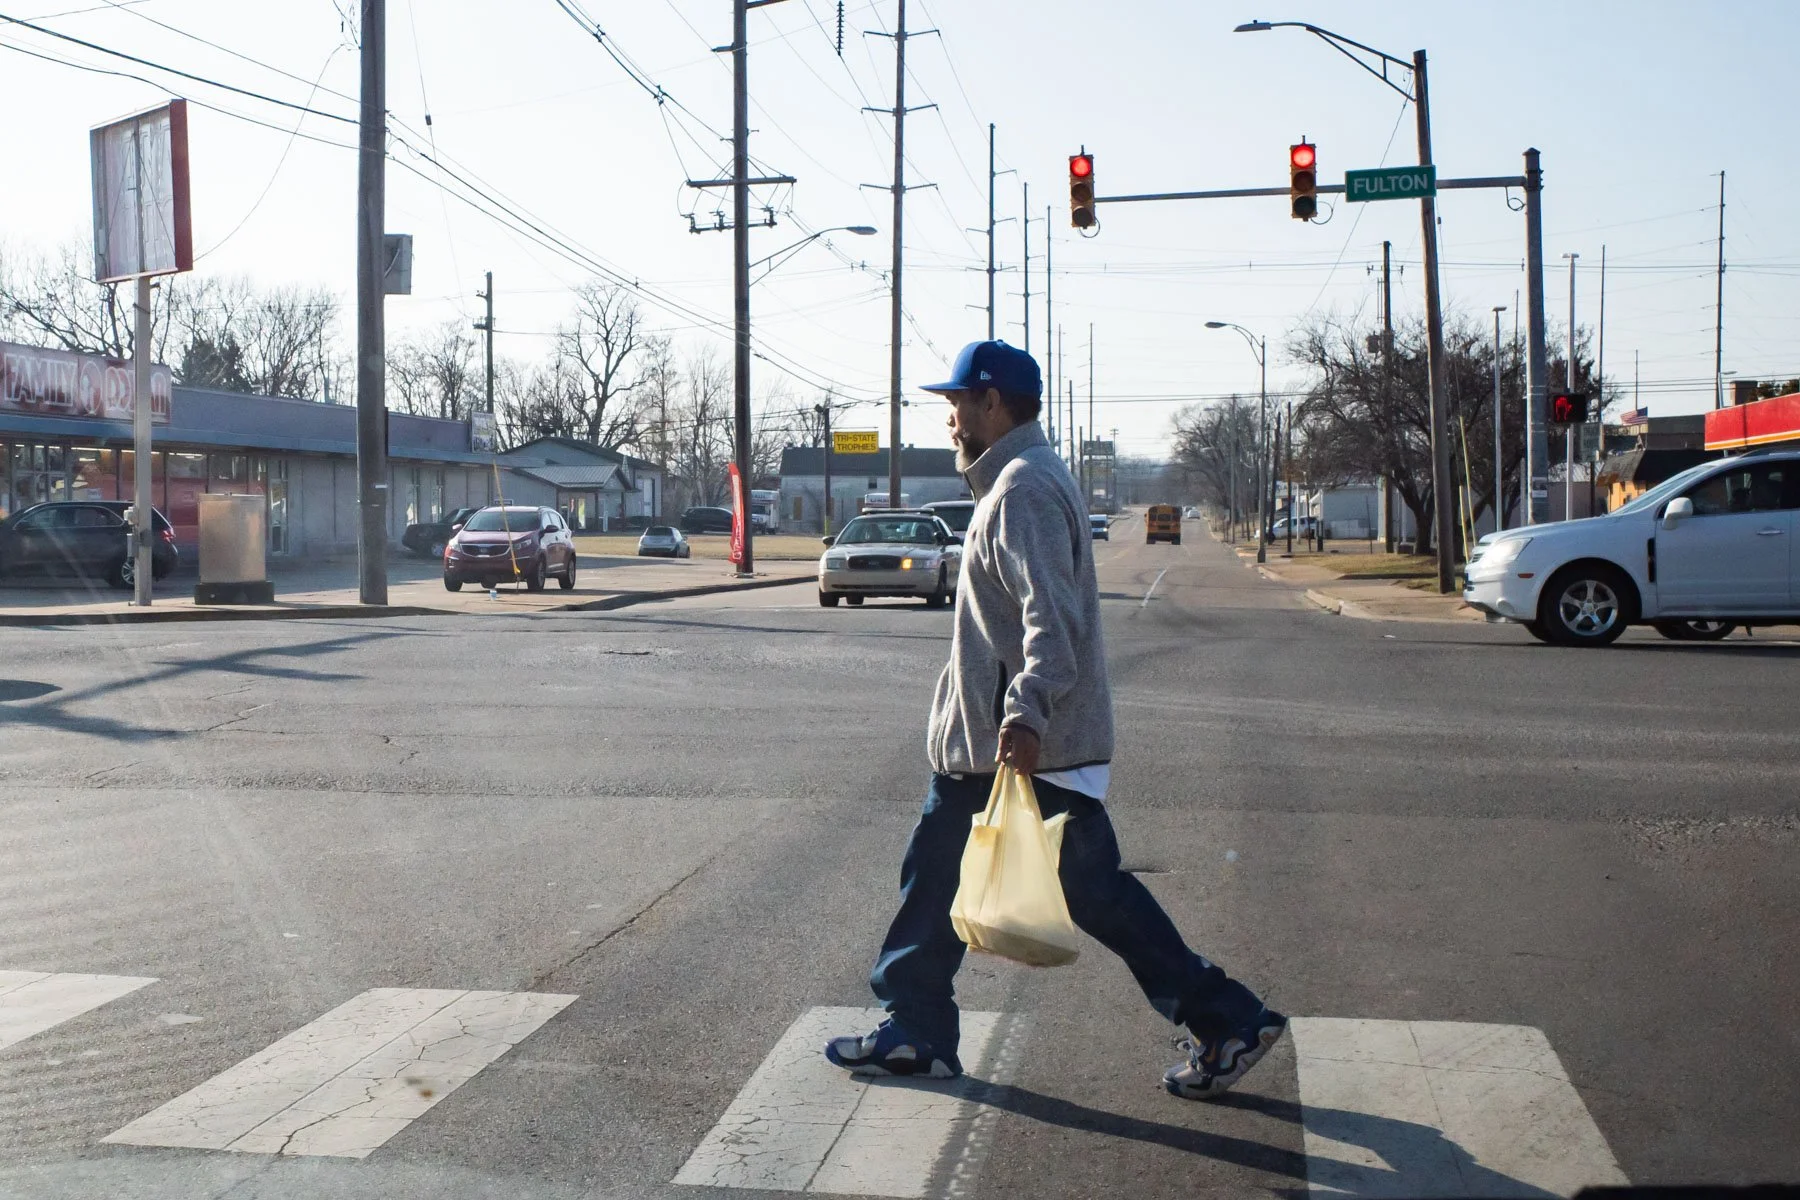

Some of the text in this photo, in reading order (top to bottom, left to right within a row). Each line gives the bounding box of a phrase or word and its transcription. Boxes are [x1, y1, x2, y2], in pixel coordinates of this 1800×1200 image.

[1353, 173, 1428, 194] FULTON
[836, 434, 876, 442] TRI-STATE
[837, 443, 876, 451] TROPHIES
